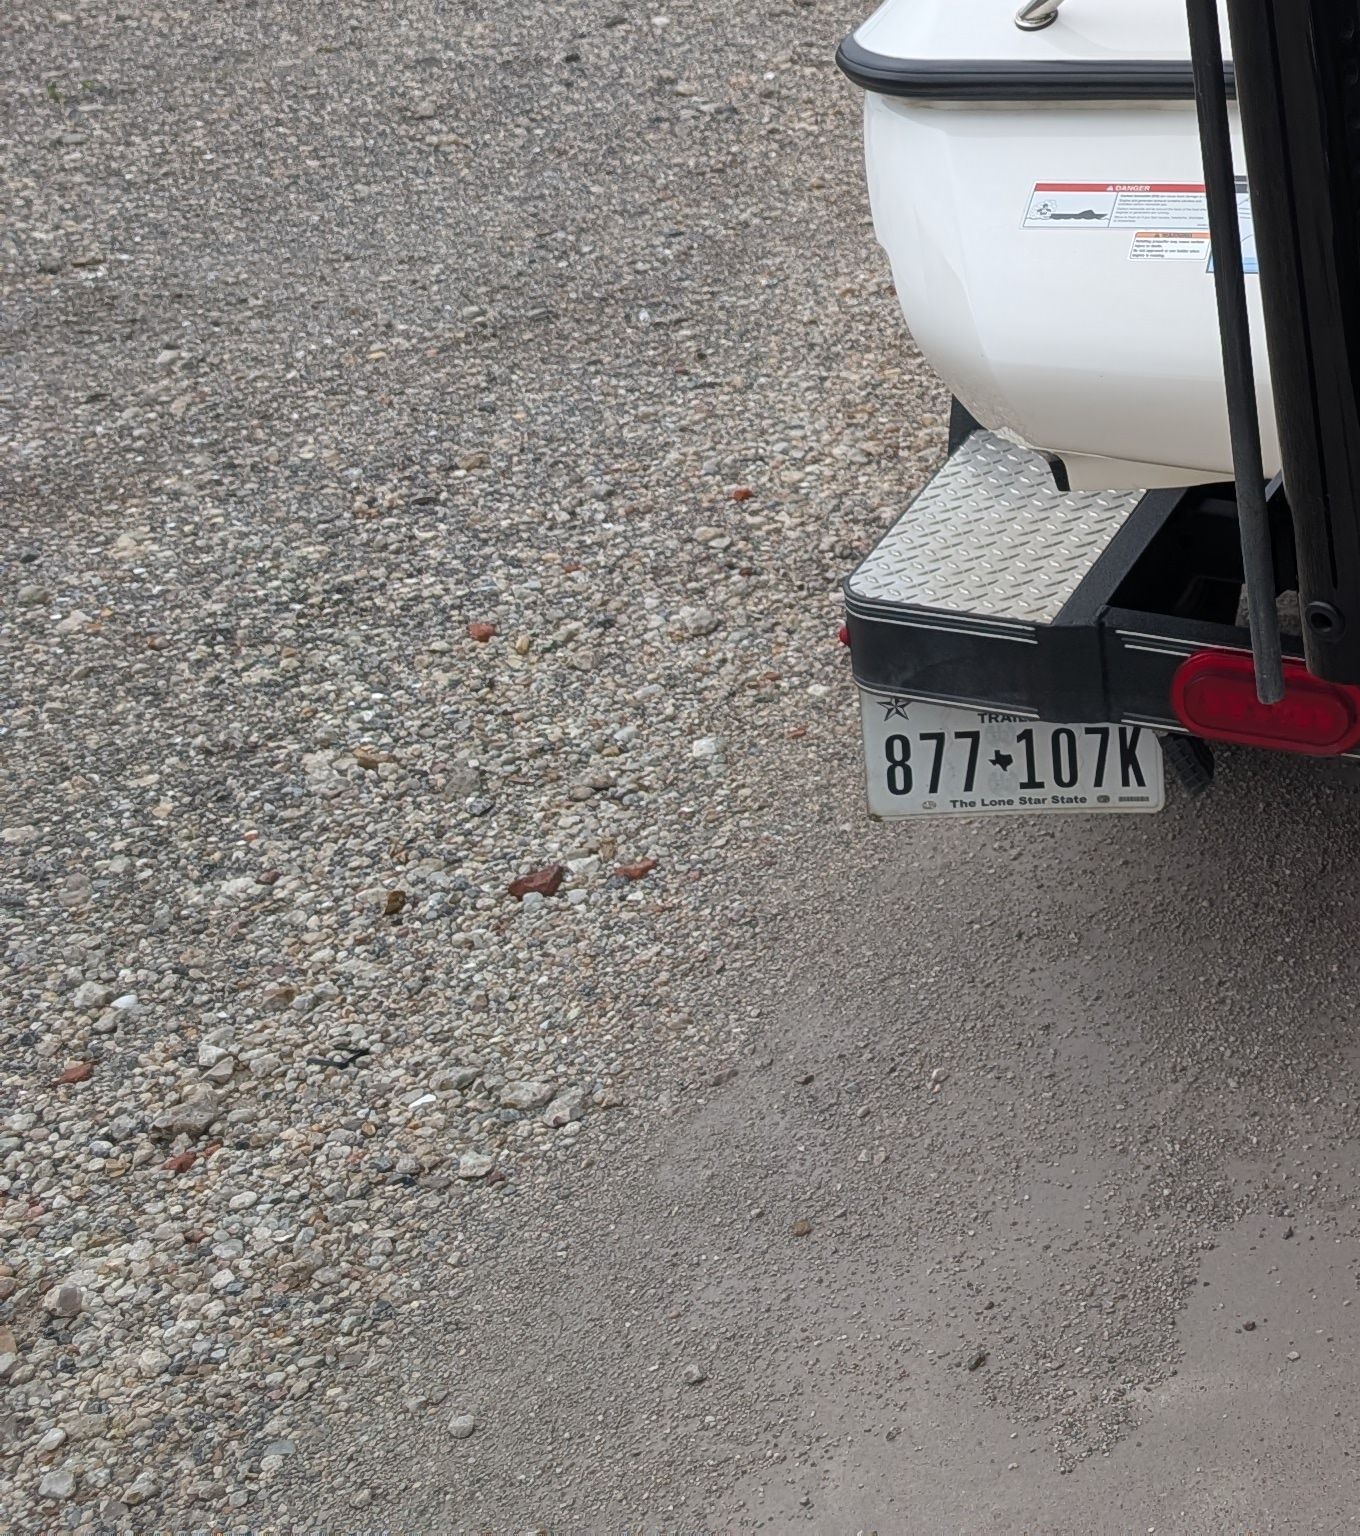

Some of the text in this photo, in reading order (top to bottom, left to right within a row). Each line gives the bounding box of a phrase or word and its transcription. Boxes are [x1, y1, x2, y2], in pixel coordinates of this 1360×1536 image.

[1114, 184, 1151, 192] DANGER
[884, 726, 1147, 796] 877 107K
[949, 795, 1088, 809] The Lone Star State
